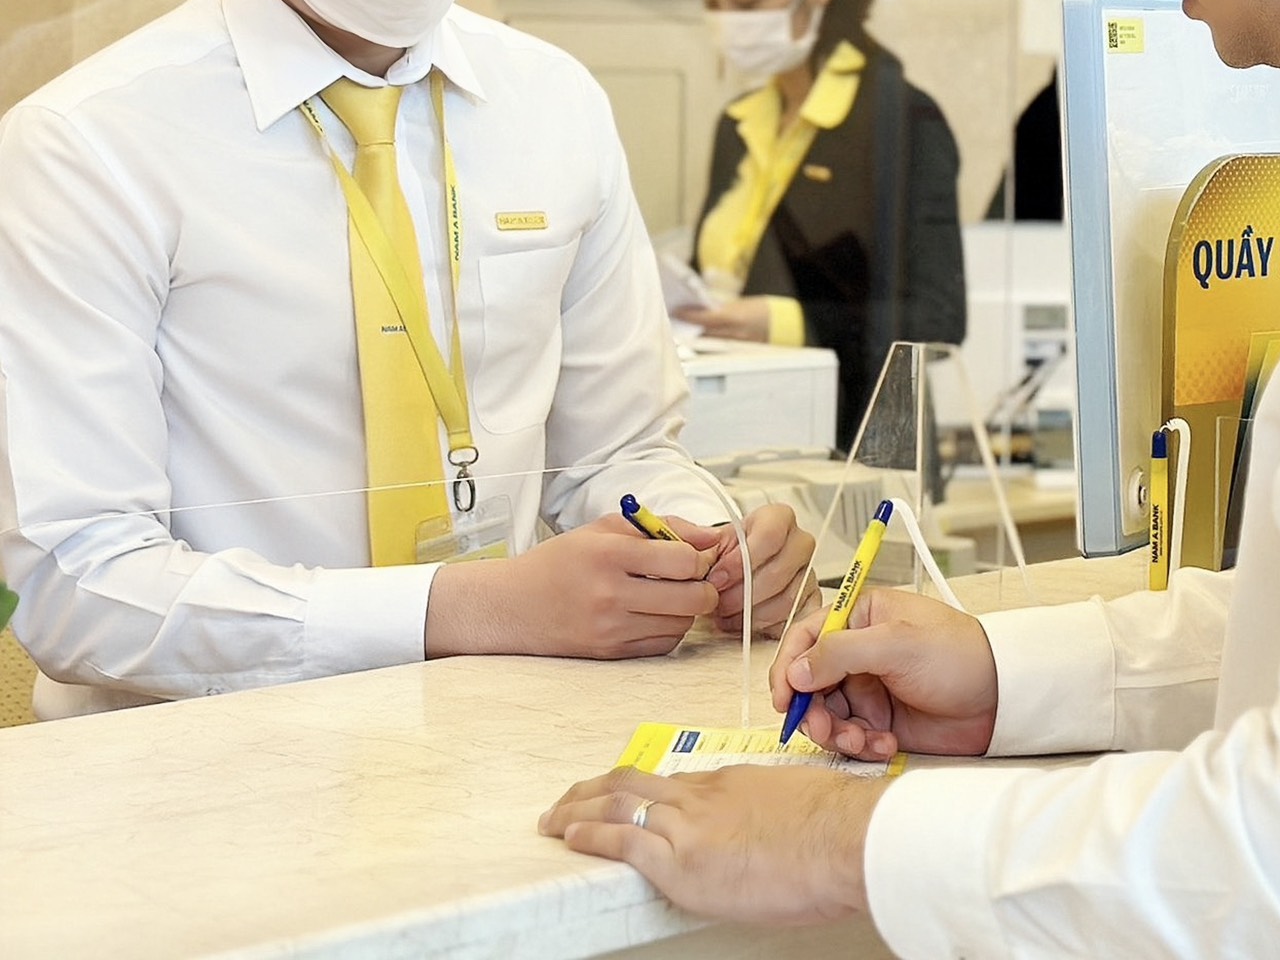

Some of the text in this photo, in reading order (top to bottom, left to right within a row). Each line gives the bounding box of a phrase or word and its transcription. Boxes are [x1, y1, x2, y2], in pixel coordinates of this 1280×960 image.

[1193, 225, 1274, 289] QUẦY
[1152, 504, 1160, 530] BANK
[1152, 532, 1159, 540] A
[833, 591, 847, 611] NAM
[846, 560, 862, 584] BANK
